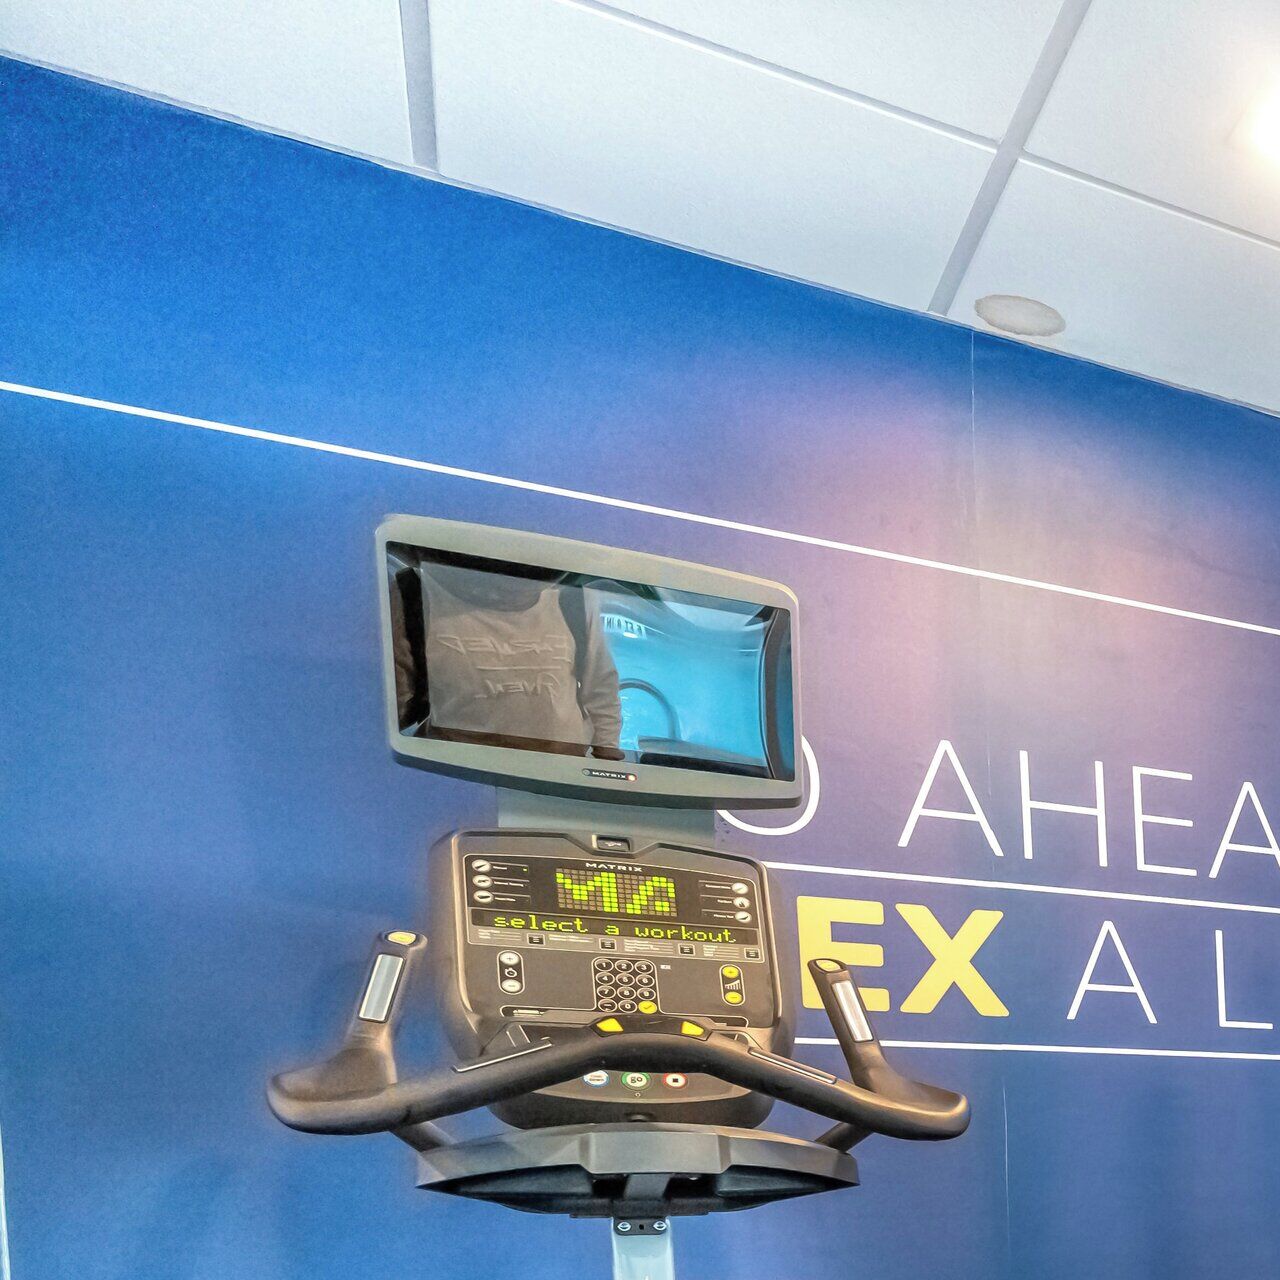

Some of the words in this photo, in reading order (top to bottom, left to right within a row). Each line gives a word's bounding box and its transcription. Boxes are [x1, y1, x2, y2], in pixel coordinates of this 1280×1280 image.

[591, 771, 627, 780] MATRIX
[585, 862, 643, 873] MATRIX
[493, 914, 589, 934] select
[604, 924, 620, 936] a
[634, 925, 737, 944] workout
[796, 895, 1011, 1018] EX
[1066, 920, 1158, 1025] A
[630, 1076, 643, 1085] go
